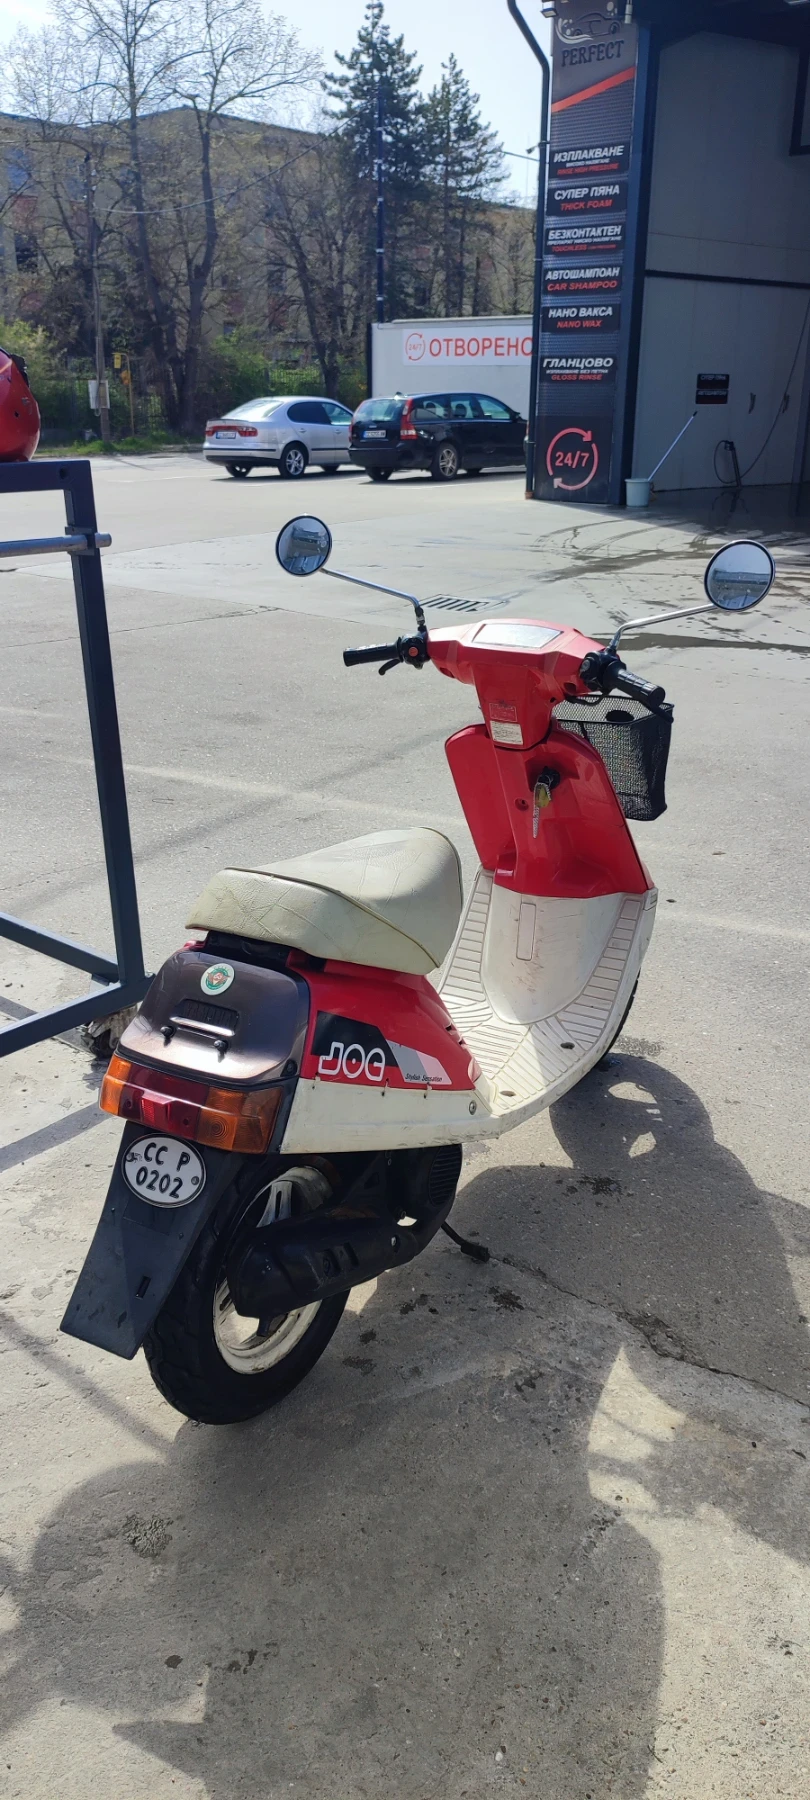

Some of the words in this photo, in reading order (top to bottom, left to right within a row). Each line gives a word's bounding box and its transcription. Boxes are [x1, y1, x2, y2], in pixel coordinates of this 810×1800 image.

[561, 40, 625, 67] PERFECT
[553, 145, 625, 163] ИЗПЛАКВАНЕ
[554, 187, 588, 200] СУПЕР
[590, 185, 620, 197] ПЯНА
[561, 202, 585, 211] THICK
[587, 199, 613, 209] FOAM
[548, 225, 622, 240] БЕЗКОНТАКТЕН
[552, 244, 587, 252] TOUCHLESS
[545, 267, 620, 281] АВТОШАМПОАН
[547, 282, 567, 291] CAR
[569, 280, 617, 290] SHAMPOO
[548, 308, 577, 318] НАНО
[579, 306, 613, 317] ВАКСА
[557, 320, 581, 329] NANO
[582, 320, 602, 328] WAX
[408, 343, 422, 351] 24/7
[543, 357, 614, 370] ГЛАНЦОВО
[555, 450, 590, 468] 24/7
[318, 1041, 386, 1082] JOG
[405, 1073, 421, 1081] Stylish
[176, 1151, 191, 1172] P
[136, 1166, 183, 1199] 0202
